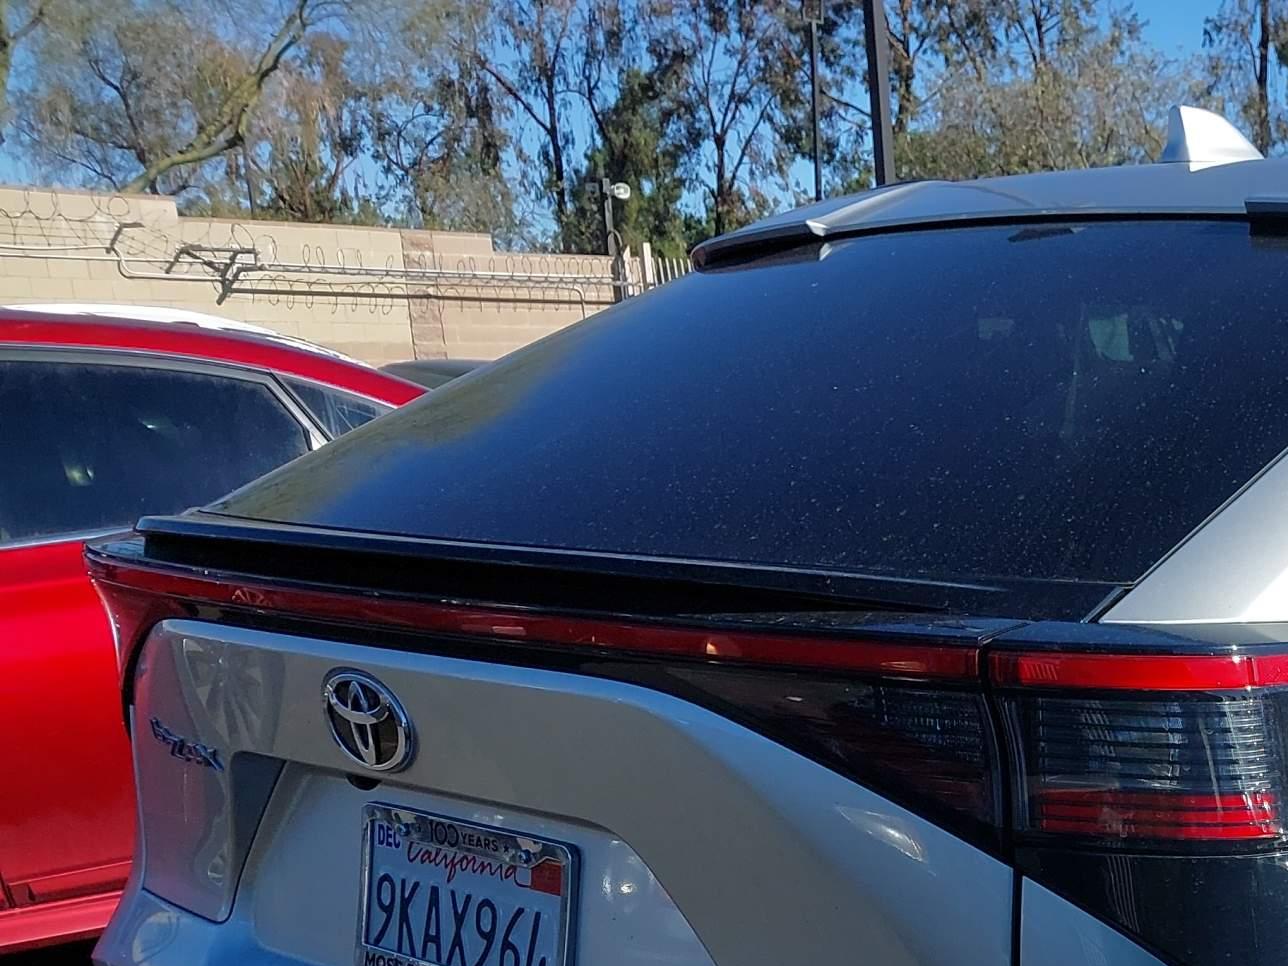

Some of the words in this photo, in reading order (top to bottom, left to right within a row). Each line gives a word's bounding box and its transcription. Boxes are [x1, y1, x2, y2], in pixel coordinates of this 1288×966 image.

[377, 823, 401, 848] DEC
[428, 820, 460, 846] 100
[461, 831, 498, 852] YEARS
